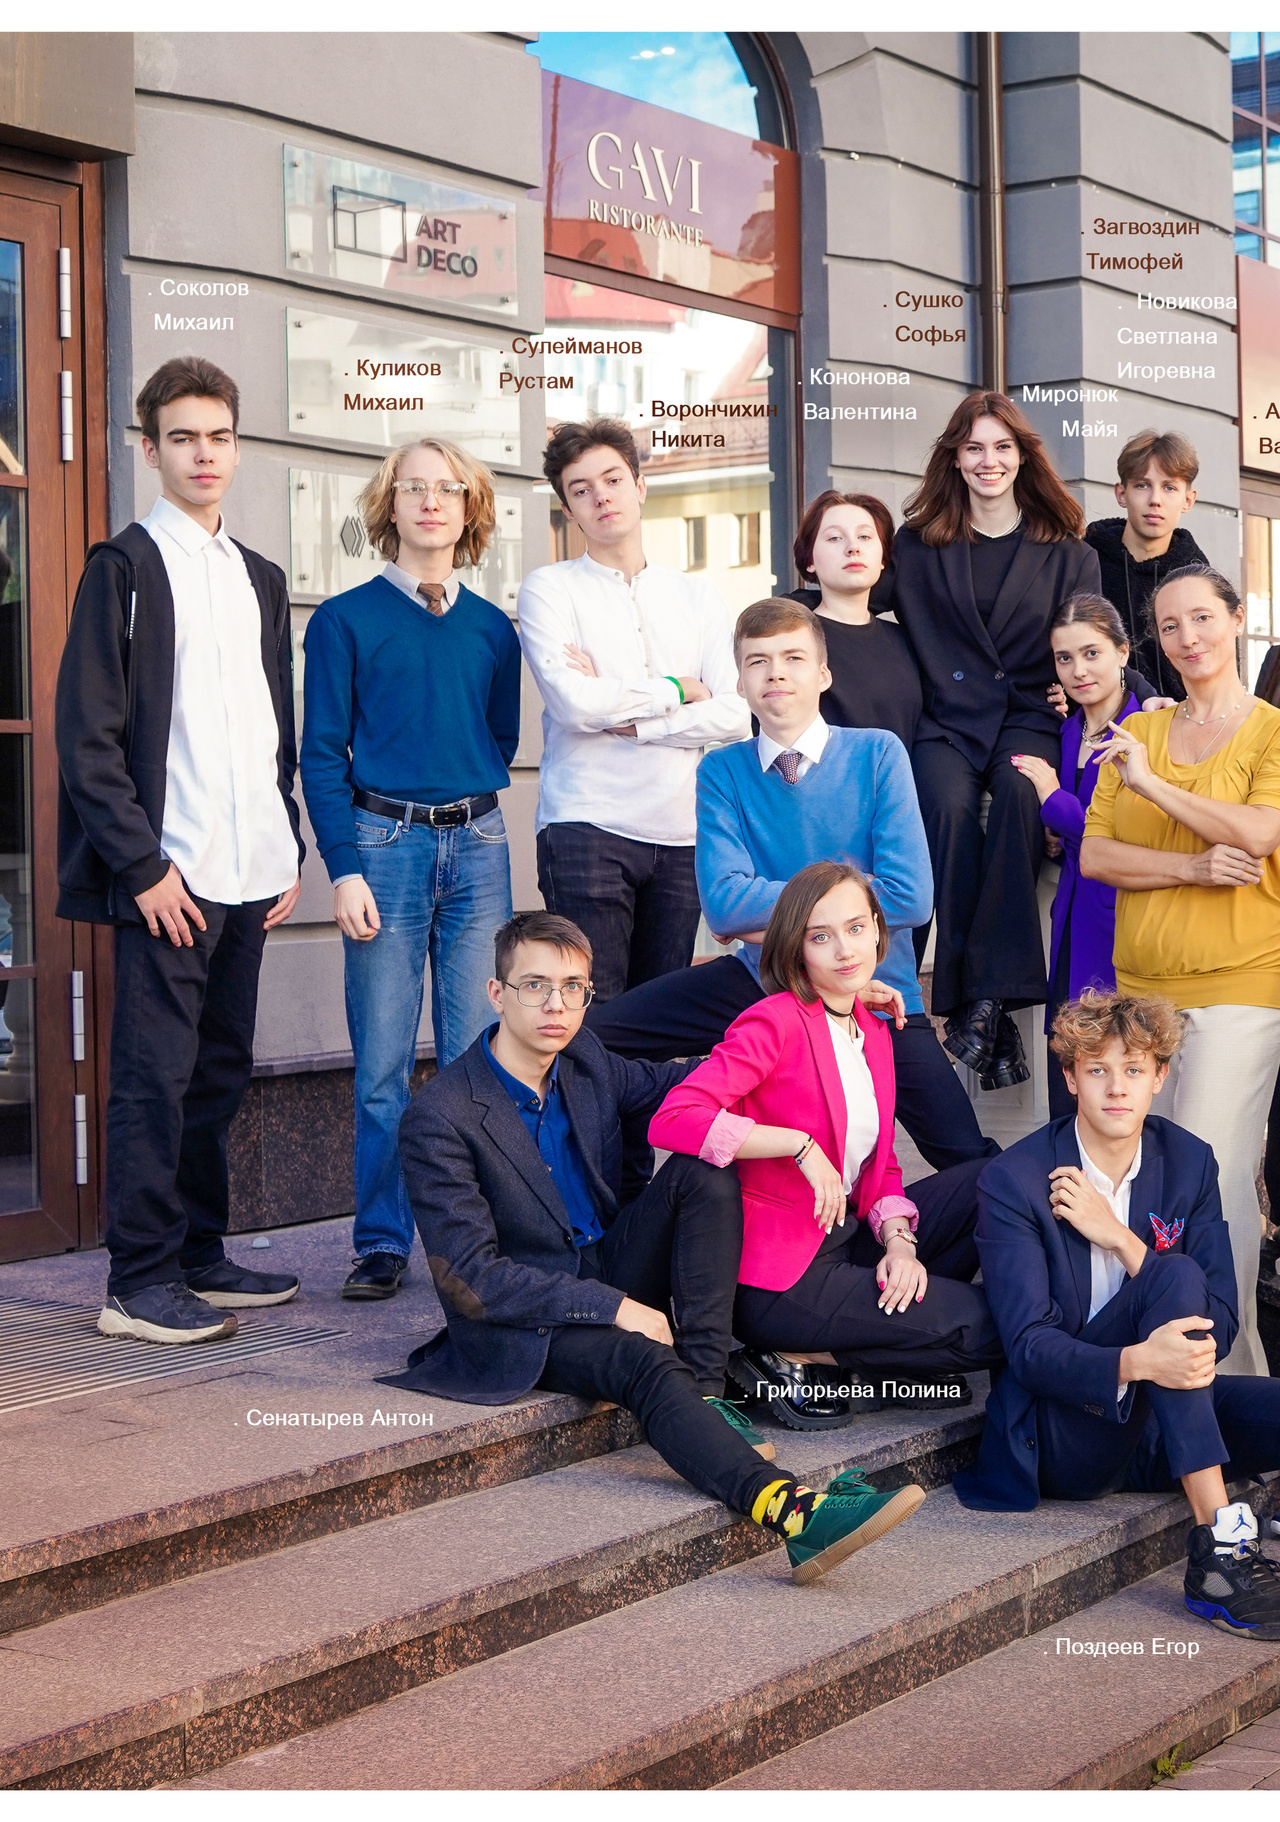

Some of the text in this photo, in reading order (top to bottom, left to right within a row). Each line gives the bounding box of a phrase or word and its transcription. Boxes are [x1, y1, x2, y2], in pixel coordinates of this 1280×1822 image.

[587, 131, 704, 215] GAVI
[415, 215, 461, 245] ART
[588, 199, 705, 248] RISTORANTE
[417, 244, 478, 279] DECO
